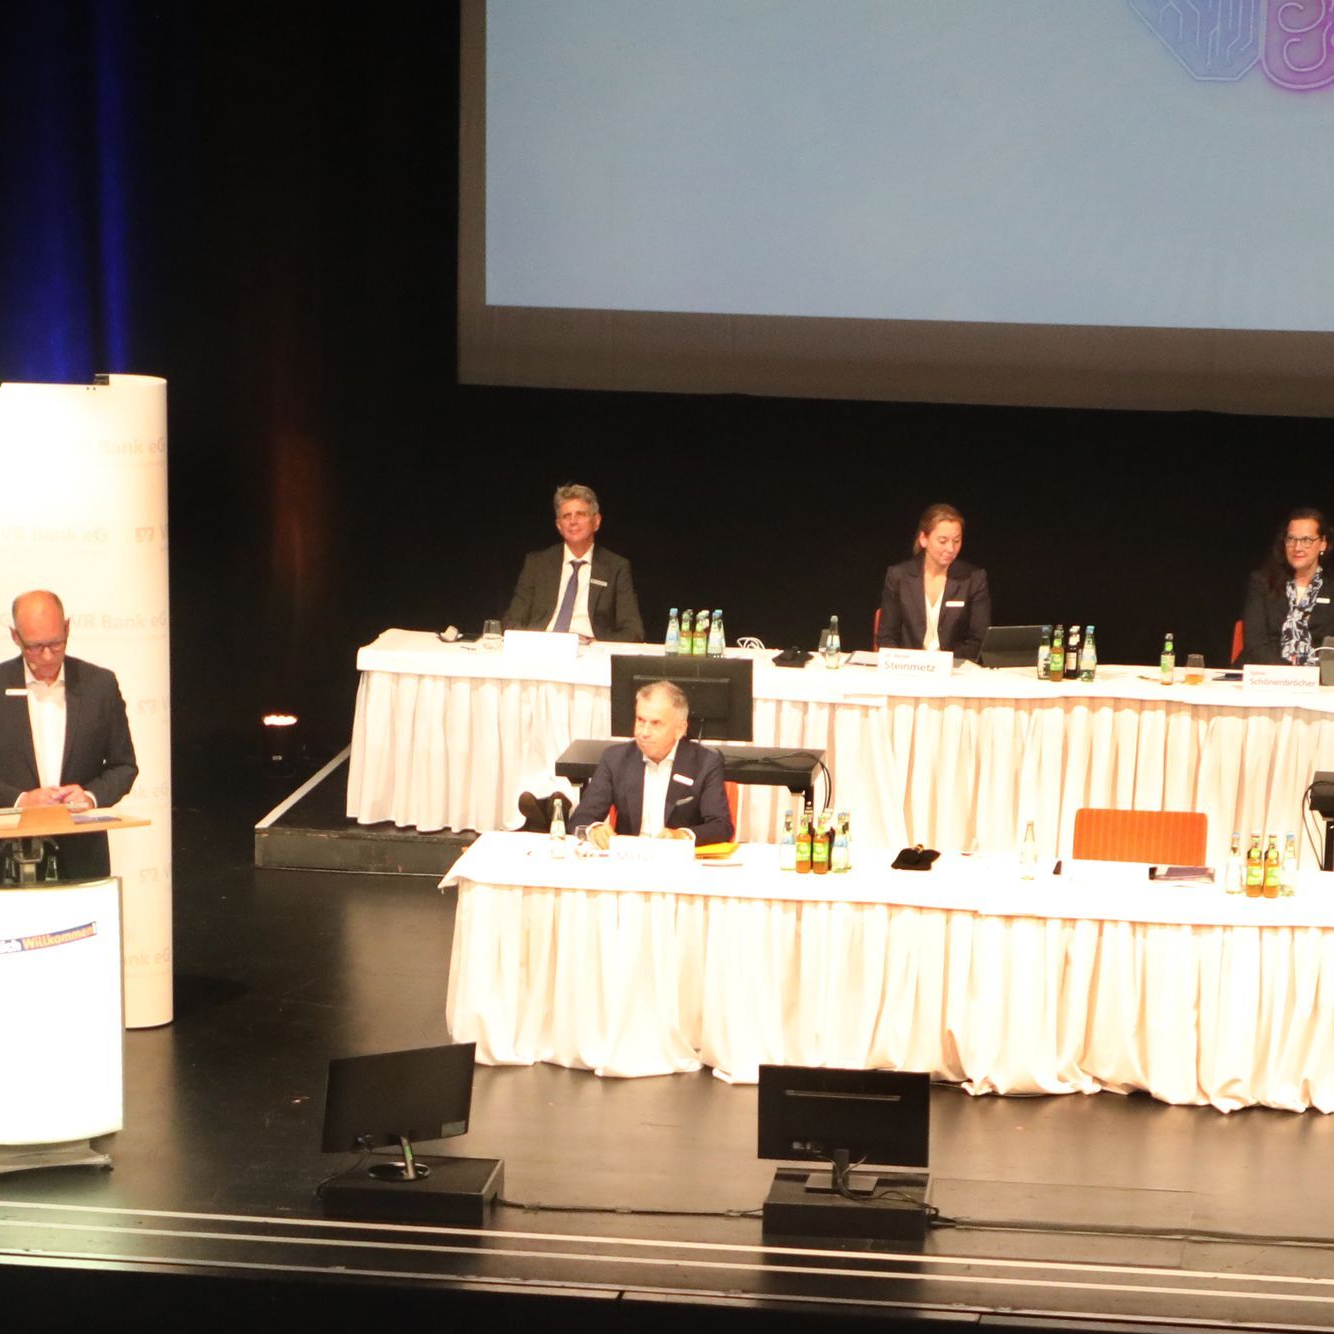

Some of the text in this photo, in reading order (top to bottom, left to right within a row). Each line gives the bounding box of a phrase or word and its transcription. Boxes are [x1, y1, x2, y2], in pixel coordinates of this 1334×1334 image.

[32, 525, 75, 543] Bank
[82, 525, 108, 543] eG
[102, 613, 146, 630] Bank
[884, 660, 936, 673] Steinmetz
